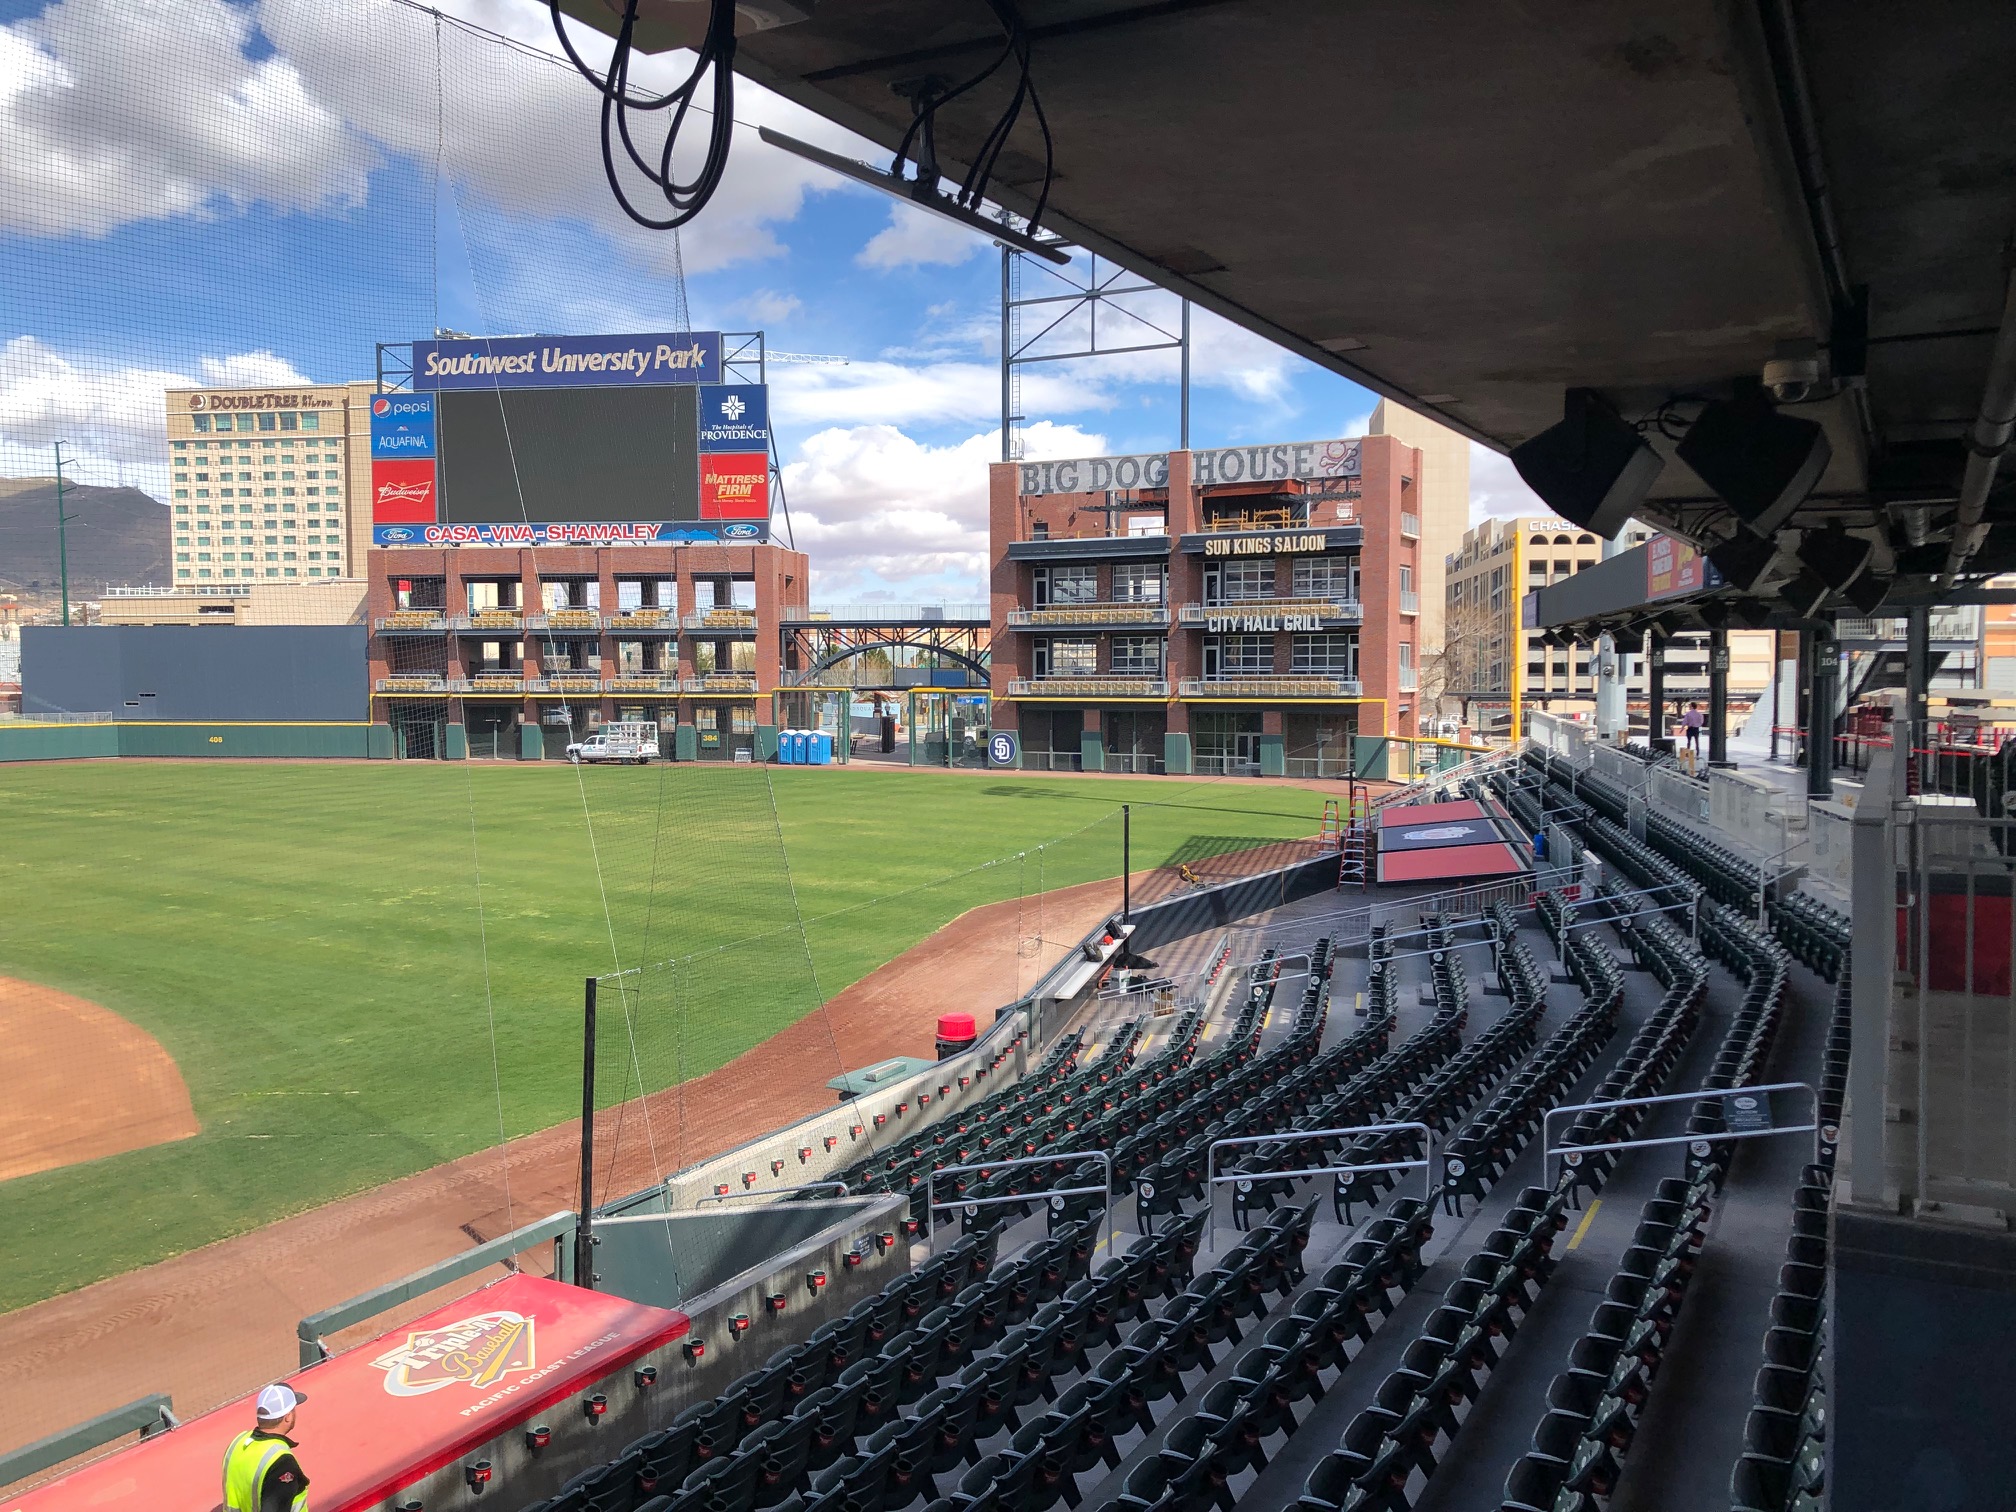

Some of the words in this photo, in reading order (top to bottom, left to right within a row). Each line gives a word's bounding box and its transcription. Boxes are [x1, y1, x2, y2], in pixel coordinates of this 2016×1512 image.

[425, 351, 536, 376] Southwest
[542, 347, 651, 377] University
[654, 342, 707, 370] Park
[394, 401, 430, 415] pepsi
[379, 435, 428, 449] AQUAFINA
[701, 430, 767, 441] PROVIDENCE
[1192, 444, 1314, 484] HOUSE
[705, 474, 765, 485] MATTRESS
[1021, 461, 1079, 495] BIG
[1088, 454, 1169, 491] DOG
[378, 485, 430, 497] Budweiser
[718, 484, 752, 495] FIRM
[387, 530, 407, 539] Ford
[731, 526, 752, 536] Ford
[1205, 539, 1231, 556] SUN
[1233, 537, 1271, 554] KINGS
[1274, 534, 1326, 552] SALOON
[1208, 616, 1239, 632] CITY
[1243, 615, 1279, 632] HALL
[1284, 614, 1323, 631] GRILL
[1821, 657, 1838, 666] 104
[702, 734, 718, 742] 384
[441, 1319, 518, 1379] Baseball
[459, 1384, 520, 1417] PACIFIC
[519, 1358, 567, 1385] COAST
[566, 1332, 621, 1360] LEAGUE
